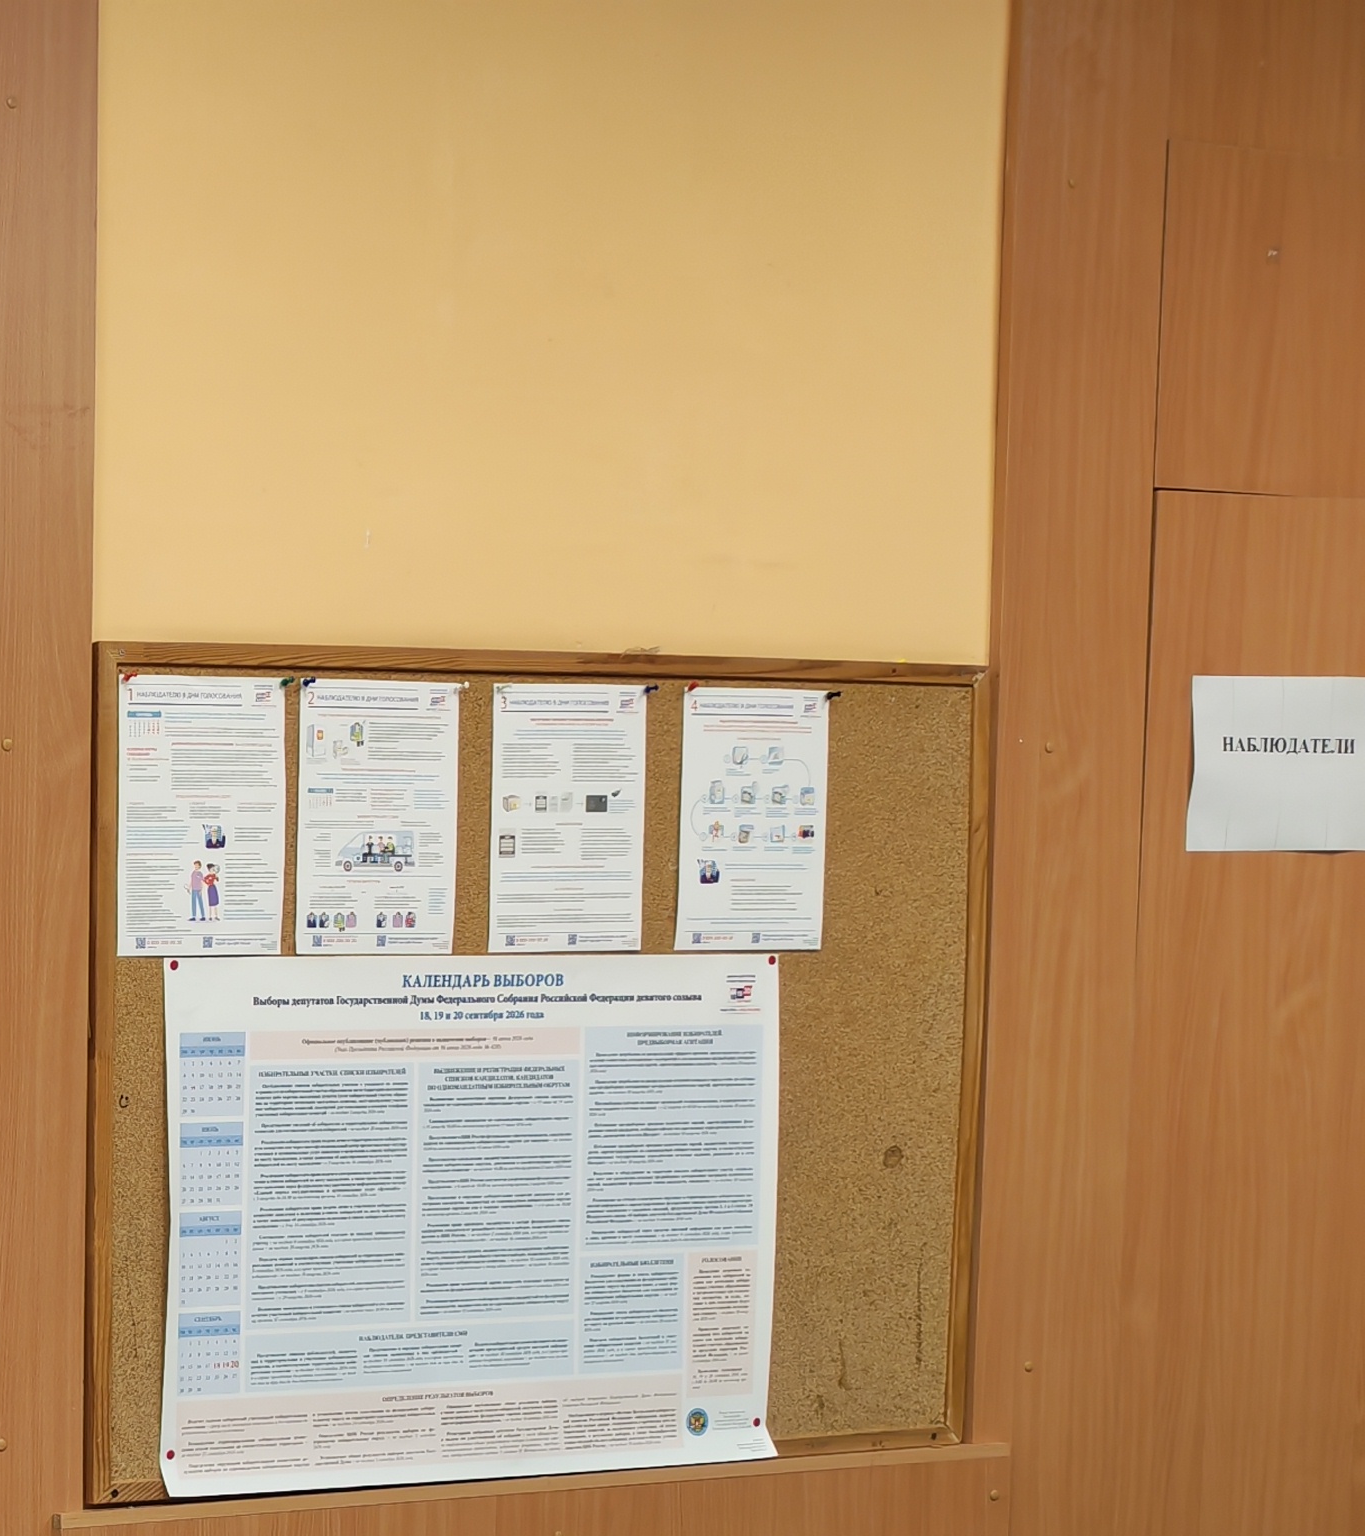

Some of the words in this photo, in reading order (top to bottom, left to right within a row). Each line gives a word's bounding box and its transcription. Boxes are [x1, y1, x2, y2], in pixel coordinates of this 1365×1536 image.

[127, 688, 133, 701] 1
[307, 691, 315, 705] 2
[500, 695, 508, 710] 3
[690, 699, 699, 712] 4
[1222, 736, 1356, 755] НАБЛЮДАТЕЛИ
[401, 974, 491, 990] КАЛЕНДАРЬ
[493, 973, 565, 988] ВЫБОРОВ
[252, 996, 290, 1008] Выборы
[291, 997, 335, 1008] депутатов
[336, 995, 409, 1008] Государственной
[409, 994, 435, 1007] Думы
[436, 994, 496, 1006] Федерального
[496, 993, 539, 1006] Собрания
[540, 993, 588, 1003] Российской
[589, 993, 635, 1004] Федерации
[636, 994, 672, 1002] девятого
[420, 1011, 432, 1021] 18,
[434, 1010, 444, 1020] 19
[453, 1011, 464, 1020] 20
[465, 1009, 504, 1022] сентября
[505, 1010, 525, 1019] 2026
[526, 1011, 545, 1020] года
